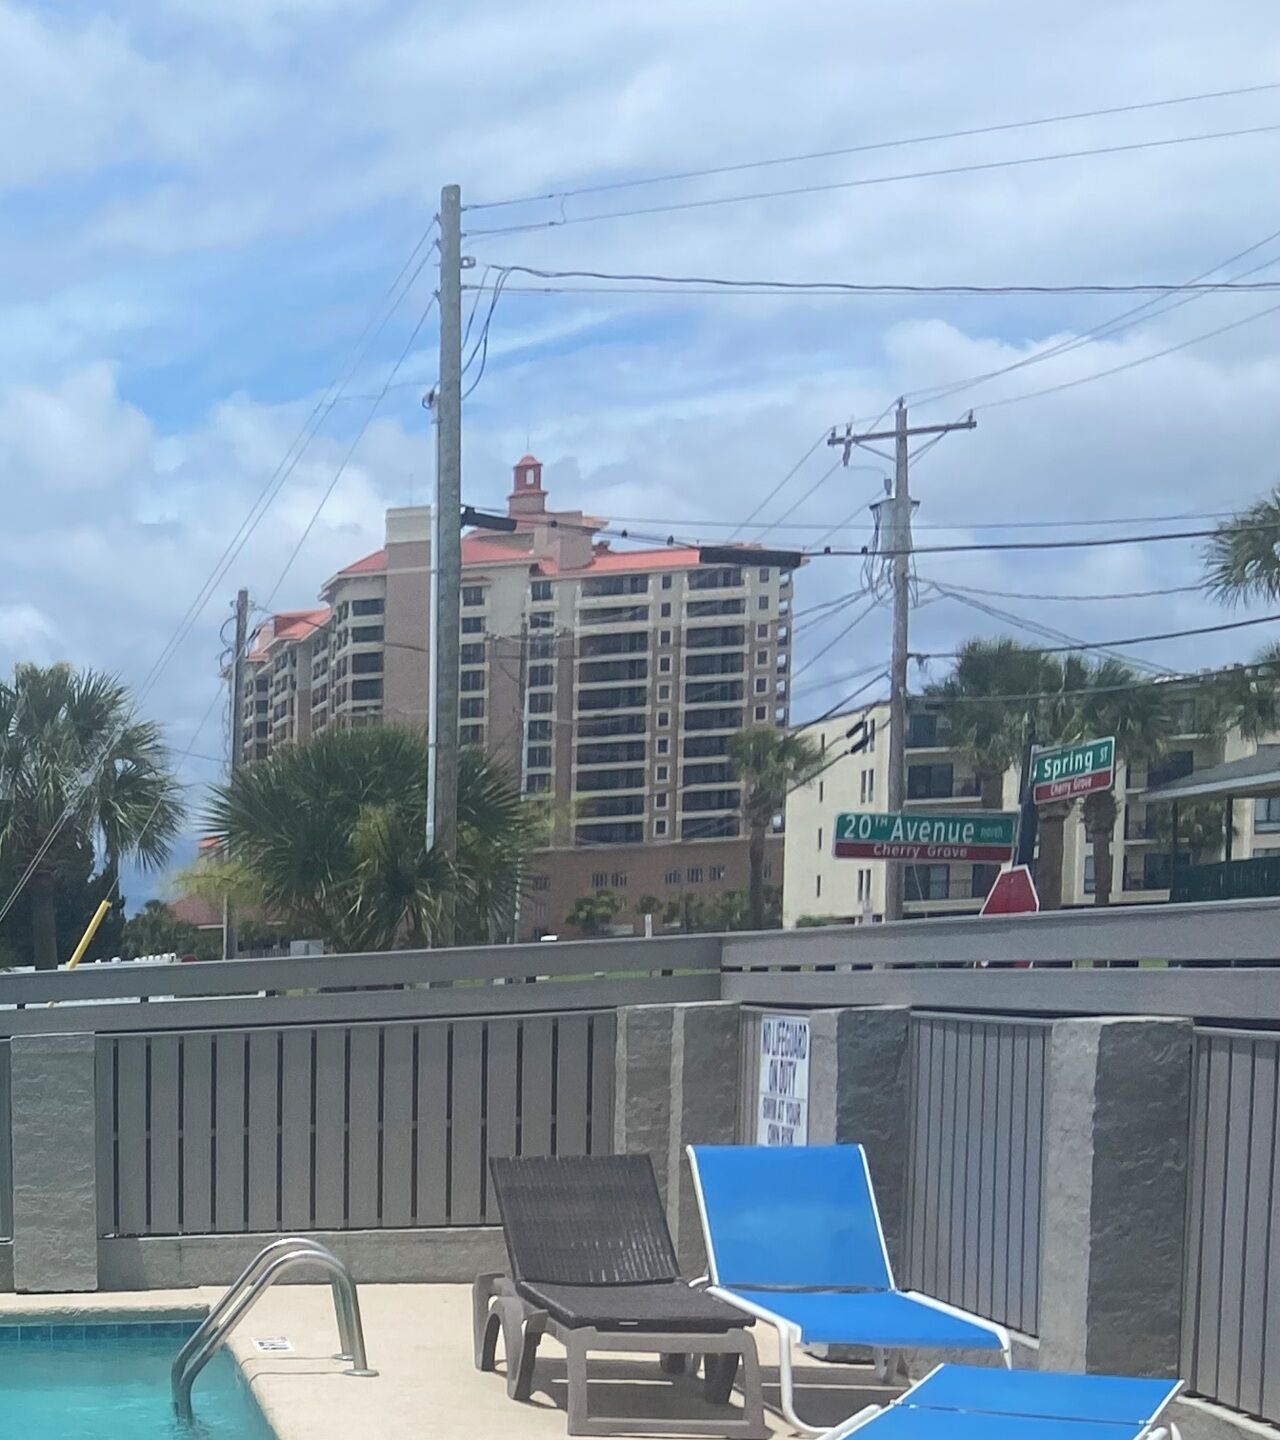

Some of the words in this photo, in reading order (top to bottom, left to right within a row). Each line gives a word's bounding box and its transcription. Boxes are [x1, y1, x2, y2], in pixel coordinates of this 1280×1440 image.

[1044, 750, 1093, 781] Spring
[1100, 746, 1108, 762] ST
[890, 816, 975, 843] Avenue
[873, 844, 921, 859] Cherry
[927, 845, 968, 858] Grove
[779, 1060, 797, 1096] DUTY
